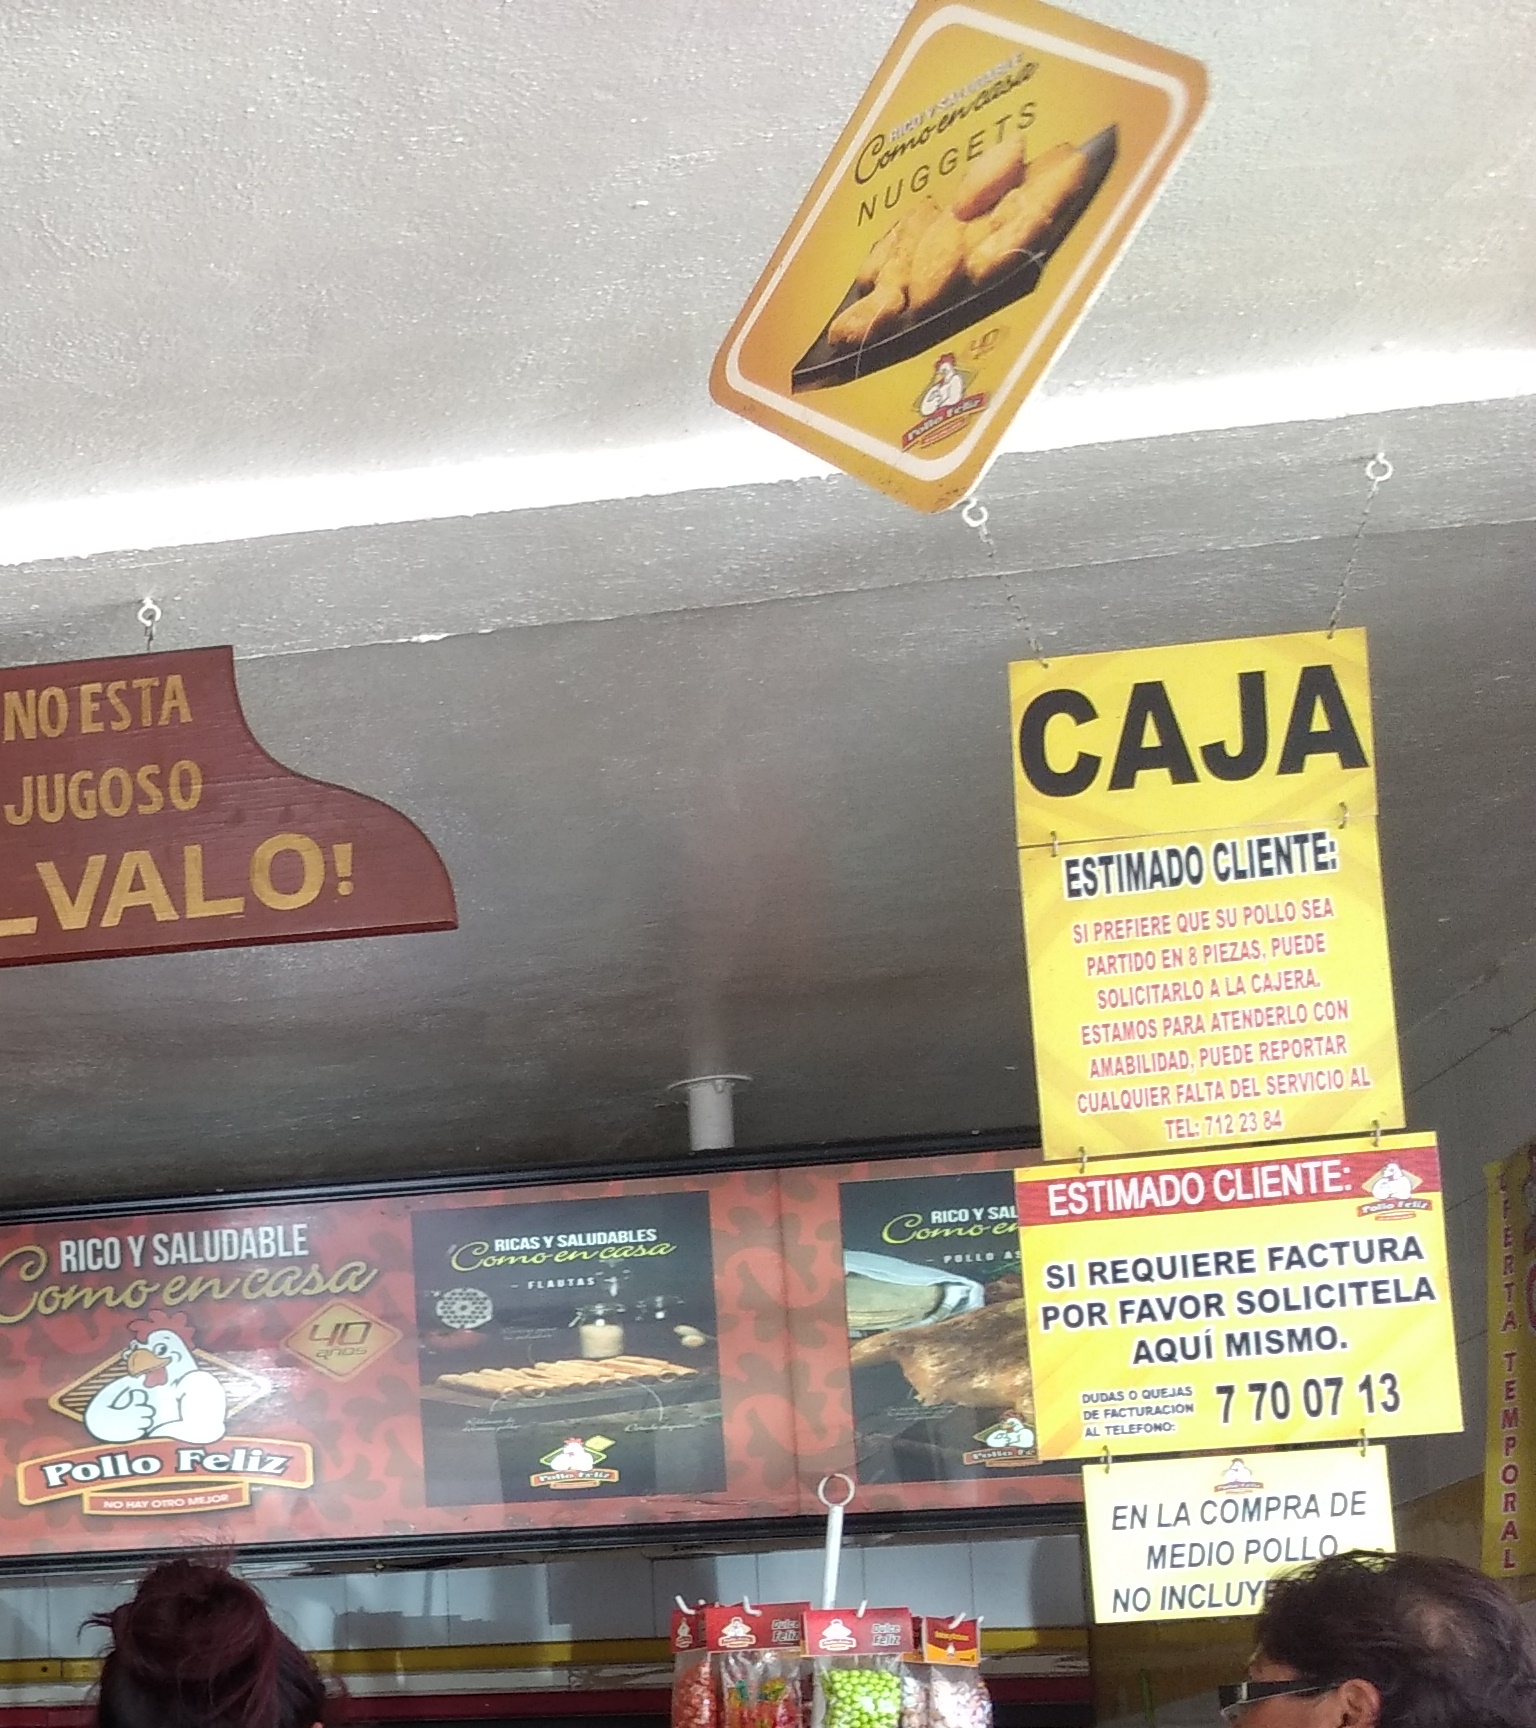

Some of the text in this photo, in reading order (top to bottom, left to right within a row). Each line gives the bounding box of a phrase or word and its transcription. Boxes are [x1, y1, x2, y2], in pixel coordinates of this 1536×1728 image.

[857, 101, 1037, 226] NUGGETS
[3, 687, 69, 743] NO
[80, 673, 194, 735] ESTA
[1019, 663, 1369, 797] CAJA
[3, 759, 203, 827] JUGOSO
[1064, 831, 1338, 899] ESTIMADO CLIENTE:
[1073, 897, 1334, 945] SI PREFIERE QUE SU POLLO SEA
[1086, 933, 1326, 977] PARTIDO EN 8 PIEZAS, PUEDE
[1097, 969, 1320, 1010] SOLICITARLO A LA CAJERA.
[1081, 1000, 1349, 1045] ESTAMOS PARA ATENDERLO CON
[1089, 1034, 1348, 1079] AMABILIDAD, PUEDE REPORTAR
[1077, 1067, 1371, 1115] CUALQUIER FALTA DEL SERVICIO AL
[1165, 1112, 1283, 1140] TEL: 712 23 84
[1047, 1159, 1353, 1217] ESTIMADO CLIENTE:
[882, 1213, 991, 1244] Como
[931, 1208, 985, 1224] RICO Y
[59, 1223, 309, 1273] RICO Y SALUDABLE
[450, 1241, 677, 1272] Como en casa
[494, 1229, 657, 1252] RICAS Y SALUDABLES
[943, 1252, 994, 1264] POLLO
[1045, 1235, 1425, 1290] SI REQUIERE FACTURA
[163, 1274, 242, 1306] en
[242, 1261, 379, 1299] casa
[527, 1277, 596, 1290] FLAUTAS
[1042, 1276, 1437, 1331] POR FAVOR SOLICITELA
[308, 1321, 373, 1345] 40
[1132, 1325, 1348, 1366] AQUÍ MISMO.
[1082, 1386, 1193, 1403] DUDAS O QUEJAS
[1083, 1410, 1099, 1420] DE
[1216, 1372, 1401, 1424] 7 70 07 13
[1085, 1427, 1100, 1437] AL
[42, 1447, 291, 1489] Pollo Feliz
[1499, 1350, 1518, 1570] TEMPORAL
[103, 1494, 229, 1509] NO HAY OTRO MEJOR
[1111, 1490, 1367, 1531] EN LA COMPRA DE
[1146, 1534, 1339, 1570] MEDIO POLLO
[1112, 1587, 1152, 1614] NO
[872, 1623, 902, 1634] Dulce
[872, 1633, 901, 1646] Feliz
